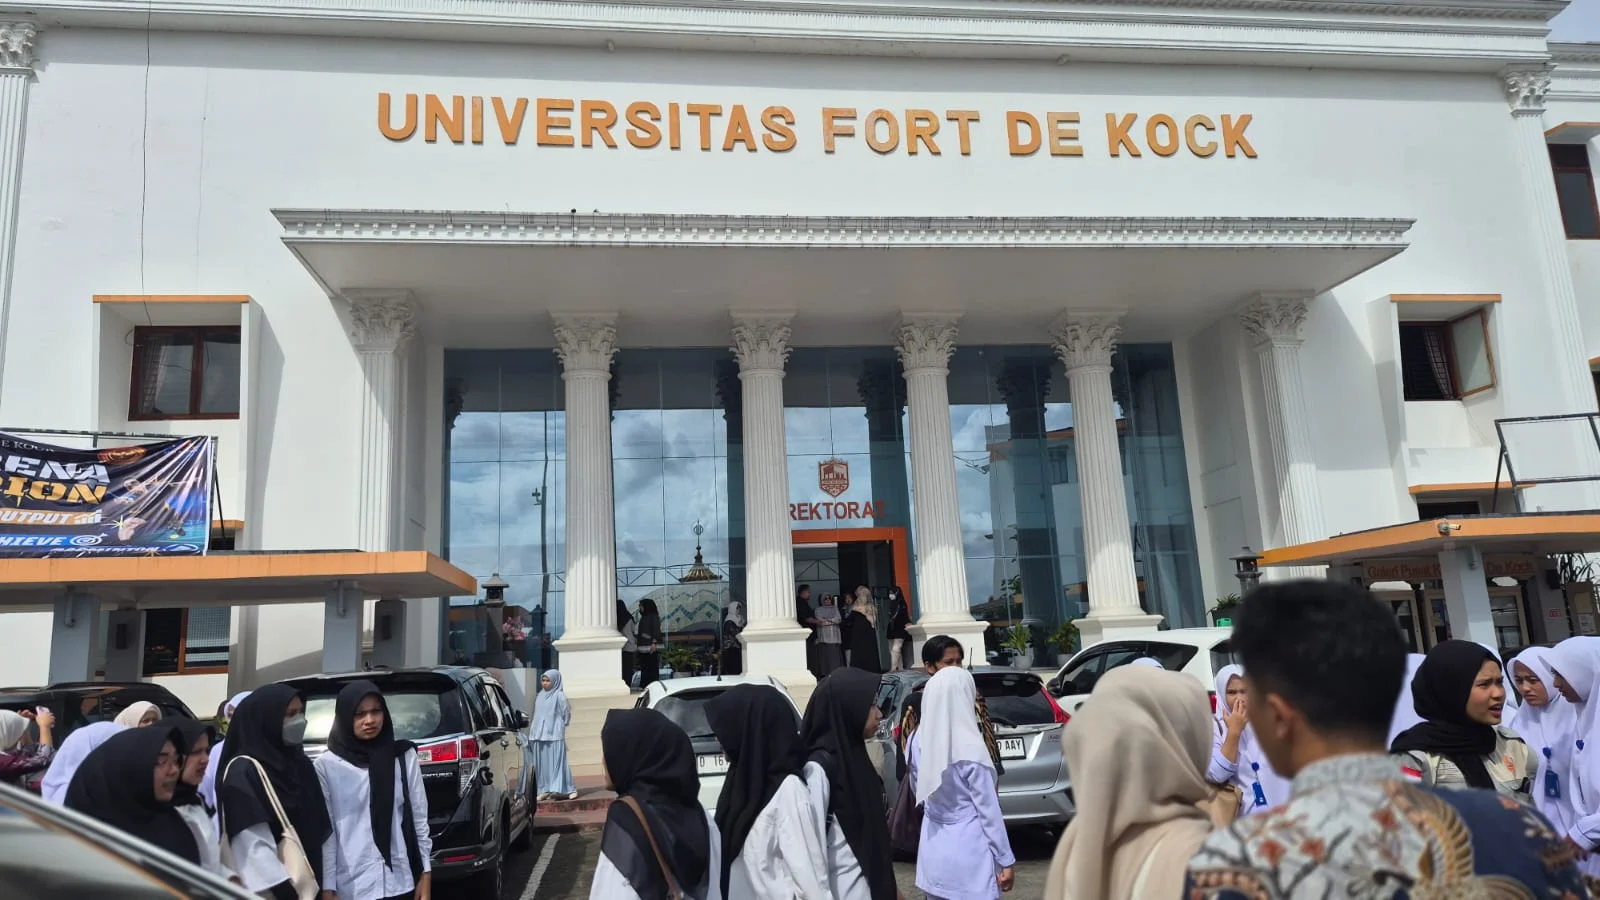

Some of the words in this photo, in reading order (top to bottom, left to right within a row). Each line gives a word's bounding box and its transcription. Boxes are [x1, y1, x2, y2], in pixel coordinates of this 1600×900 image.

[378, 92, 797, 152] UNIVERSITAS
[822, 106, 981, 156] FORT
[1006, 110, 1083, 157] DE
[1105, 112, 1258, 159] KOCK
[0, 455, 110, 483] ENA
[0, 476, 107, 505] ION
[0, 511, 73, 525] UTPUT
[789, 501, 886, 521] REKTORAT
[1006, 740, 1020, 750] AAY
[714, 755, 727, 767] 16
